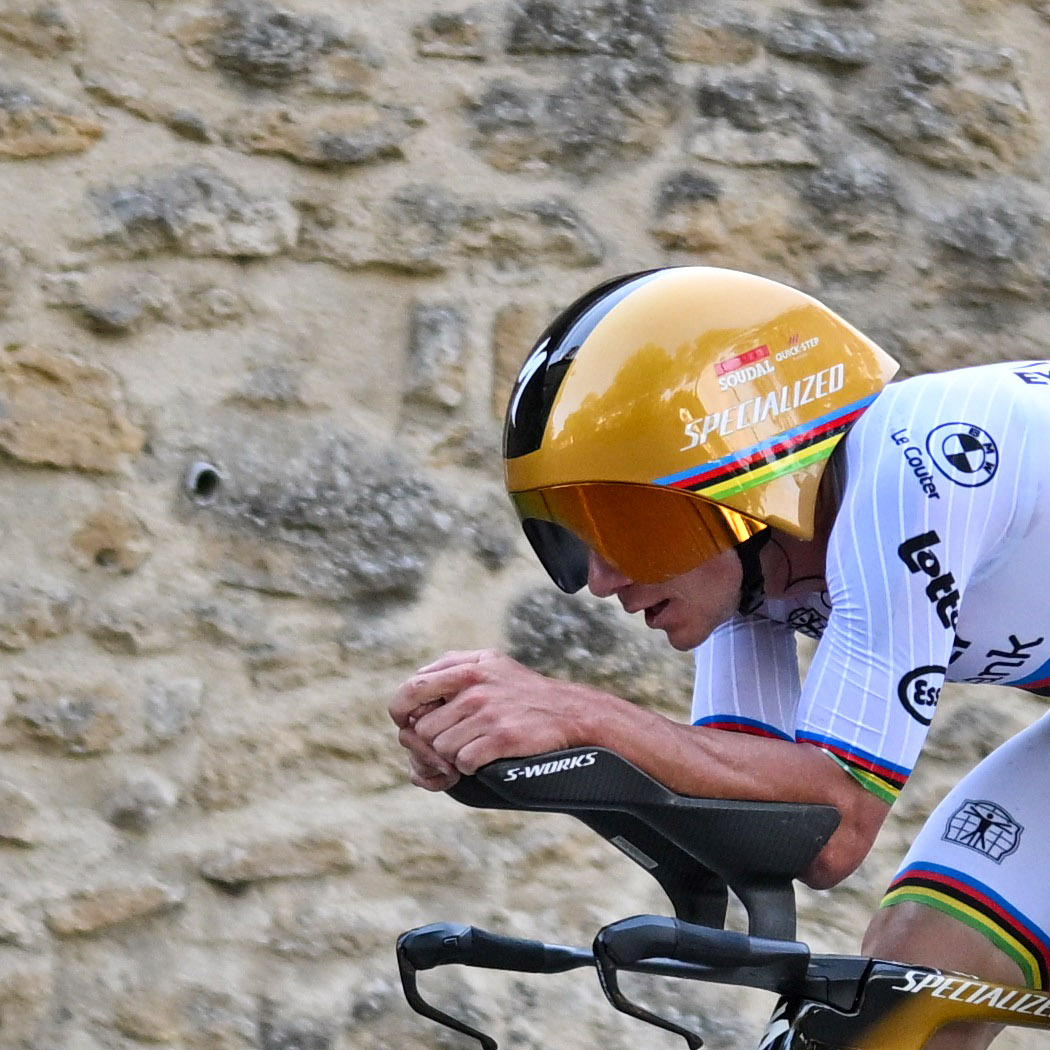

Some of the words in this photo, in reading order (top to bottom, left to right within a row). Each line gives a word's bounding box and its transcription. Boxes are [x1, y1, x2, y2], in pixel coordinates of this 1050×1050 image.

[775, 336, 820, 362] QUICK-STEP
[718, 359, 775, 392] SOUDAL
[679, 363, 845, 452] SPECIALIZED
[890, 428, 910, 446] Le
[903, 446, 941, 500] Couter
[503, 751, 599, 783] S-WORKS
